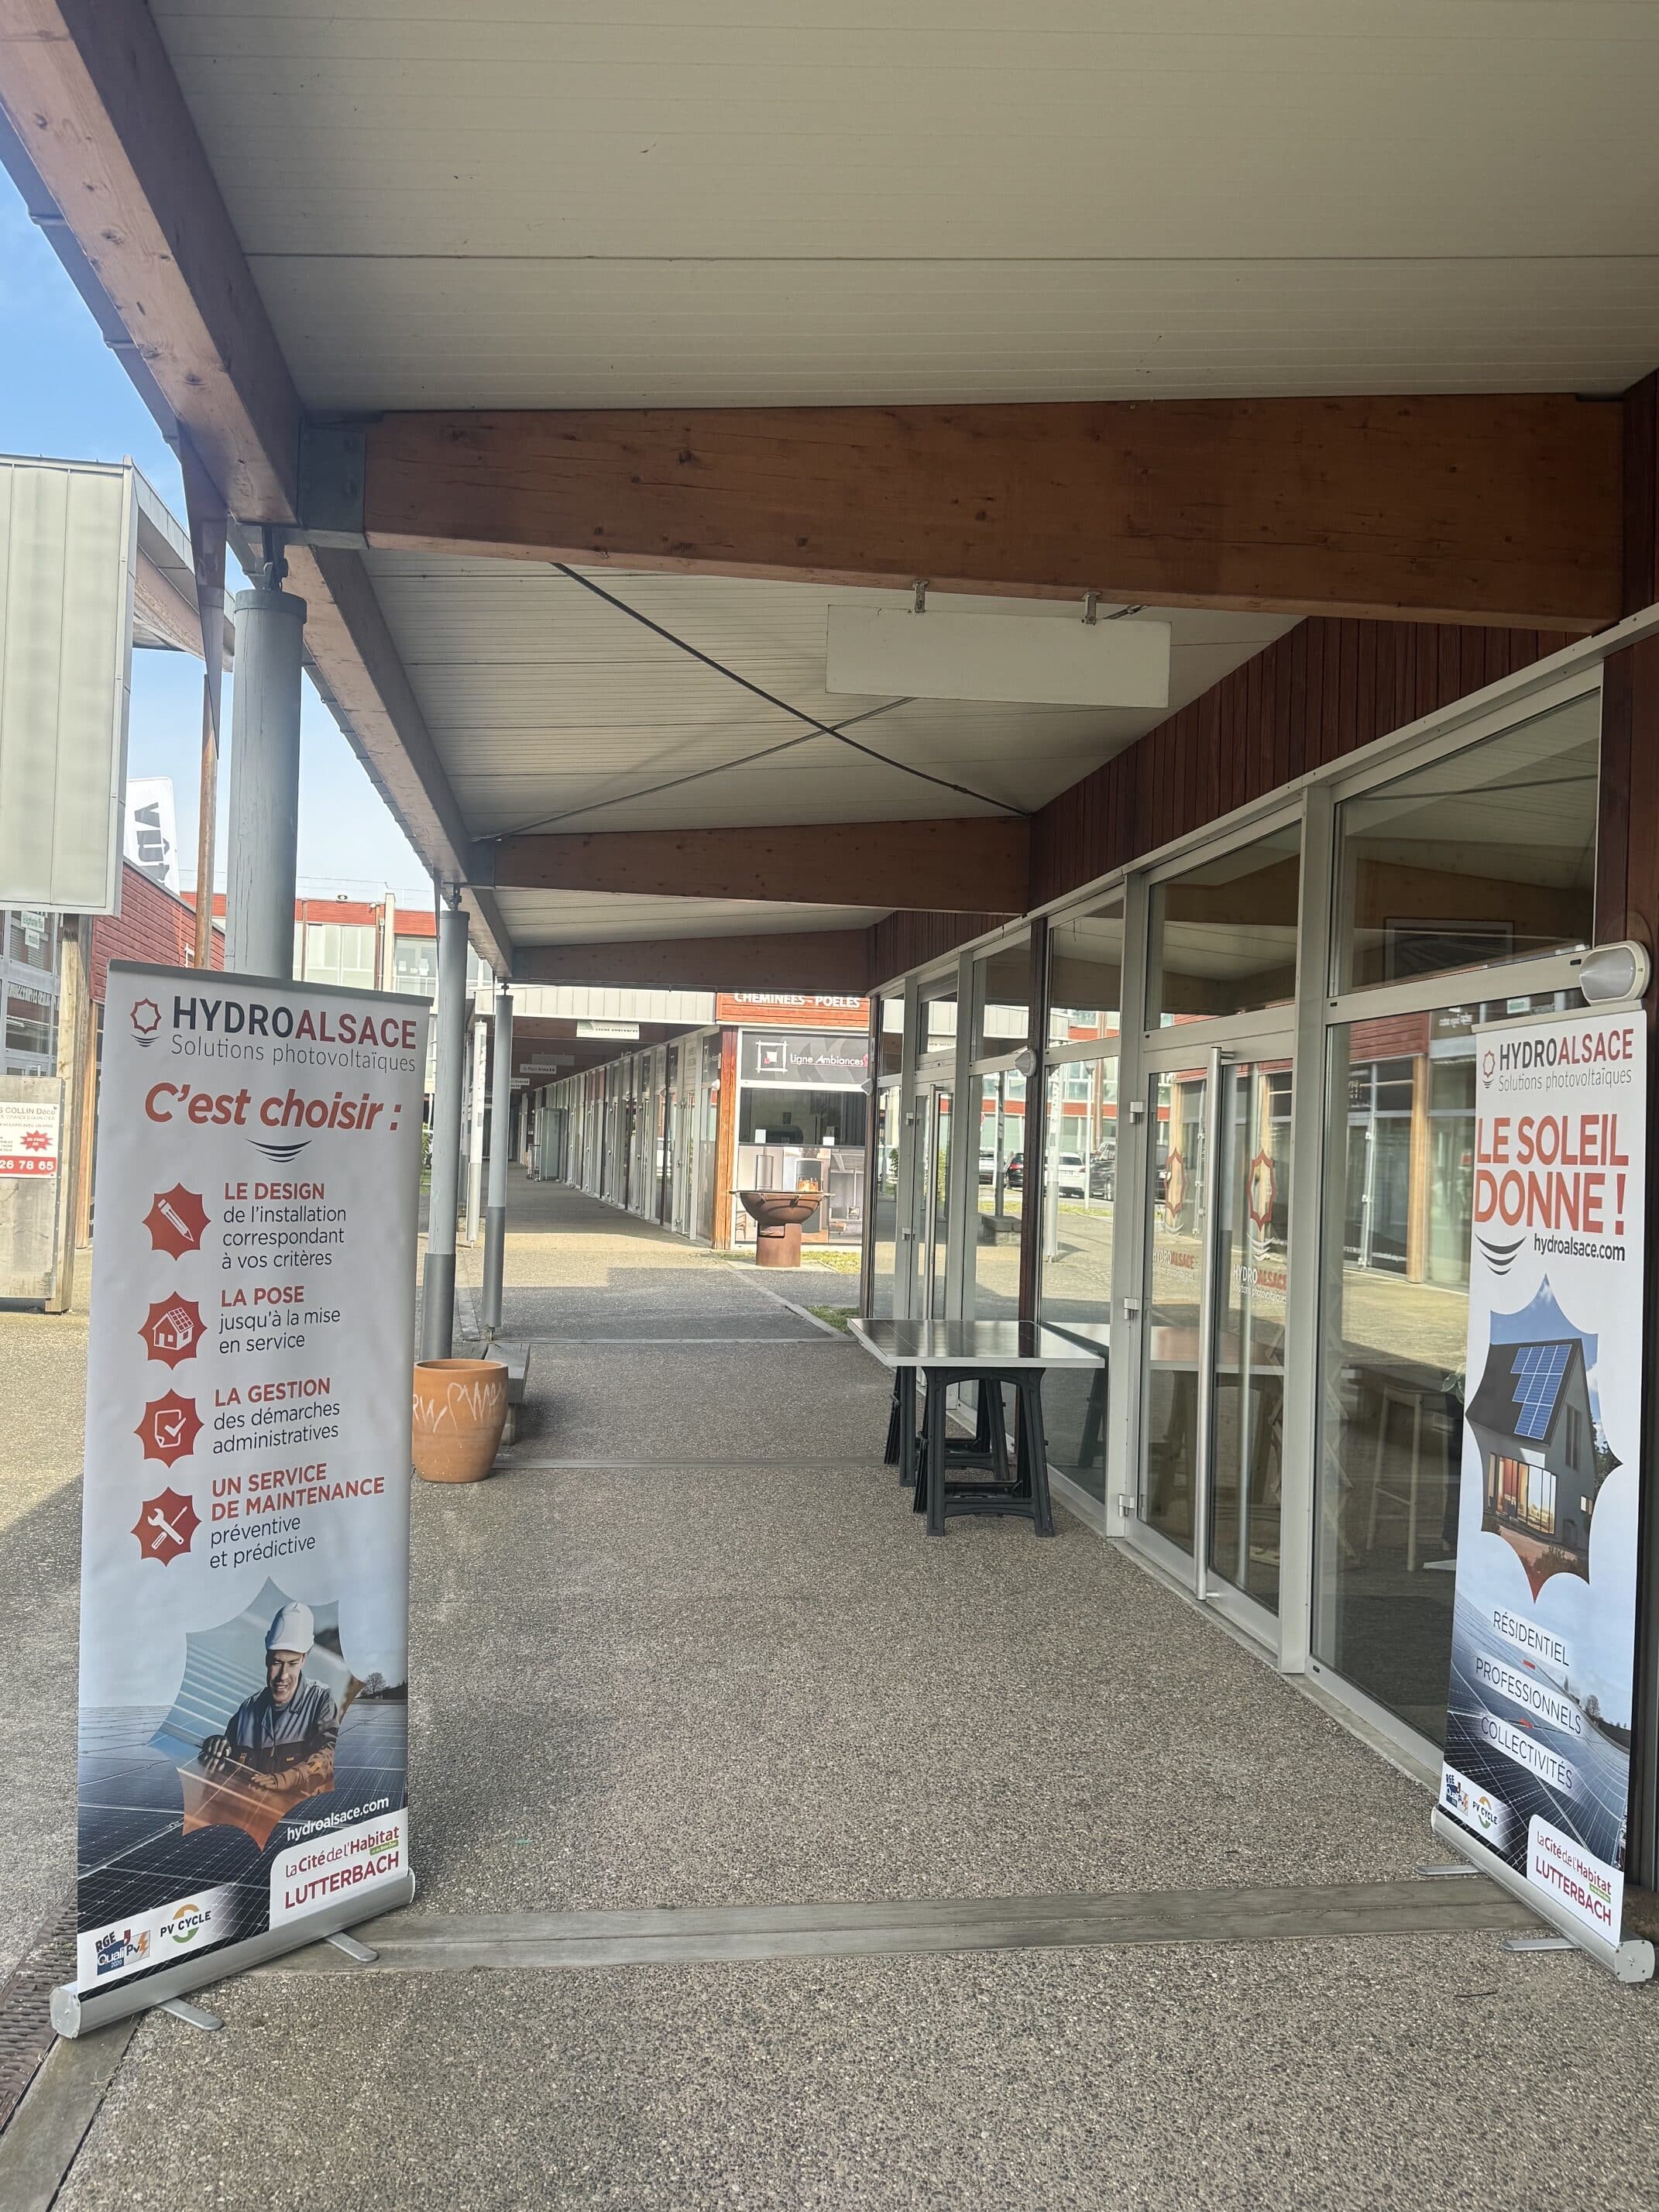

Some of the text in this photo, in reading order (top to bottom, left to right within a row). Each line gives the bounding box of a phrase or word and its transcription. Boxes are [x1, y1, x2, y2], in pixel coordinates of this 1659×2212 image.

[173, 995, 417, 1049] HYDROALSACE
[171, 1034, 416, 1073] Solutions photovoltaïques
[790, 1053, 864, 1066] Ligne Ambiances
[1499, 1029, 1634, 1070] HYDROALSACE
[1498, 1068, 1632, 1092] Solutions photovoltaïques
[145, 1082, 252, 1125] C'est
[259, 1089, 383, 1131] choisir
[1477, 1114, 1630, 1166] LE SOLEIL
[19, 1160, 34, 1170] 78
[39, 1160, 54, 1171] 65
[225, 1183, 325, 1200] LE DESIGN
[1475, 1170, 1606, 1233] DONNE
[223, 1206, 346, 1223] de l'installation
[223, 1228, 345, 1248] correspondant
[1534, 1233, 1626, 1262] hydroalsace.com
[222, 1250, 332, 1269] à vos critères
[222, 1286, 304, 1307] LA POSE
[218, 1307, 341, 1334] jusqu'à la mise
[219, 1333, 305, 1354] en service
[215, 1377, 331, 1407] LA GESTION
[214, 1402, 340, 1431] des démarches
[213, 1424, 339, 1455] administratives
[212, 1462, 327, 1498] UN SERVICE
[211, 1476, 385, 1521] DE MAINTENANCE
[211, 1516, 301, 1548] préventive
[210, 1536, 316, 1568] et prédictive
[1493, 1611, 1570, 1667] RÉSIDENTIEL
[1476, 1657, 1582, 1734] PROFESSIONNELS
[1481, 1717, 1573, 1789] COLLECTIVITÉS
[287, 1797, 390, 1842] hydroalsace.com
[285, 1851, 399, 1909] LUTTERBACH
[1536, 1856, 1611, 1926] LUTTERBACH
[160, 1911, 211, 1937] PV CYCLE
[95, 1931, 116, 1953] RGE
